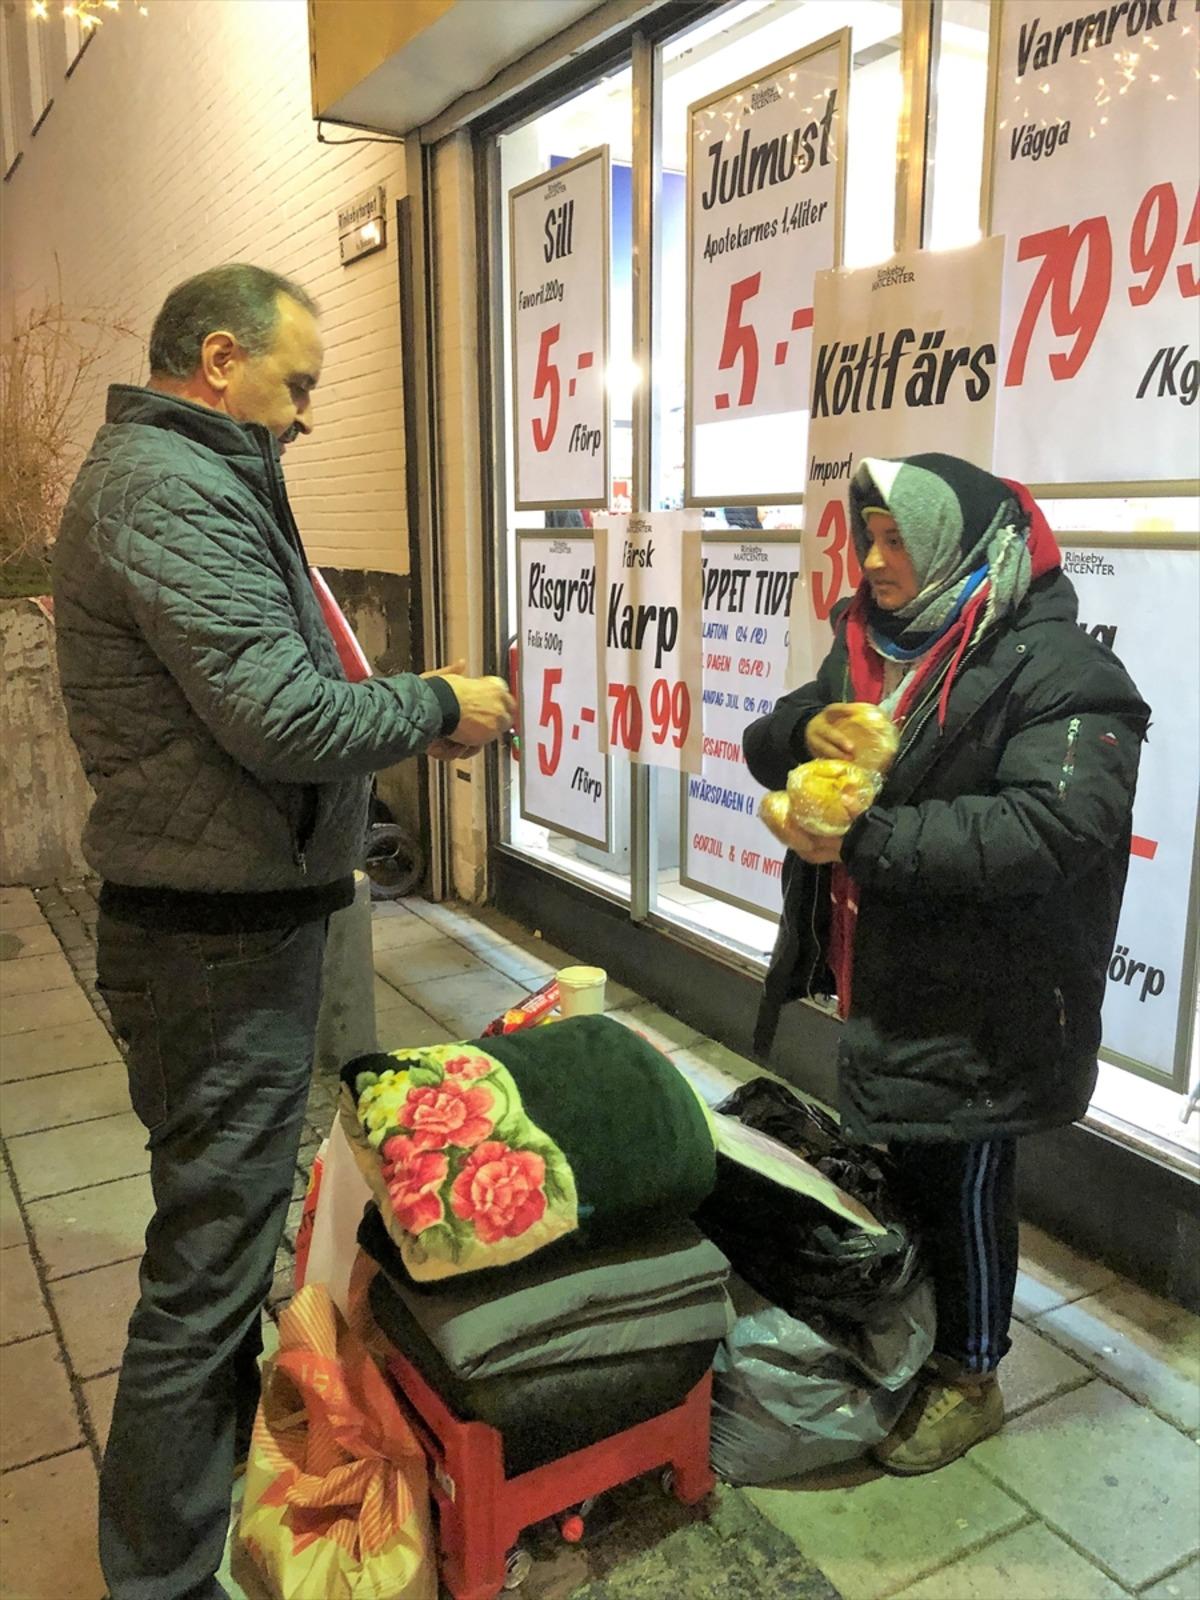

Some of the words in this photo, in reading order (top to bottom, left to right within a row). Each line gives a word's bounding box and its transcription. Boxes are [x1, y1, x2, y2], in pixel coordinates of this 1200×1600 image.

[703, 90, 838, 211] Julmust
[1010, 120, 1071, 161] Vägga
[544, 200, 574, 263] Sill
[704, 219, 778, 263] Apotekarnes
[811, 328, 996, 419] Köttfärs
[809, 452, 852, 487] Import
[1065, 551, 1104, 566] Rinkeby
[528, 562, 596, 622] Risgröt
[607, 583, 678, 669] Karp
[608, 683, 643, 752] 70
[650, 678, 691, 749] 99
[728, 846, 735, 862] &
[741, 850, 760, 870] GOTT
